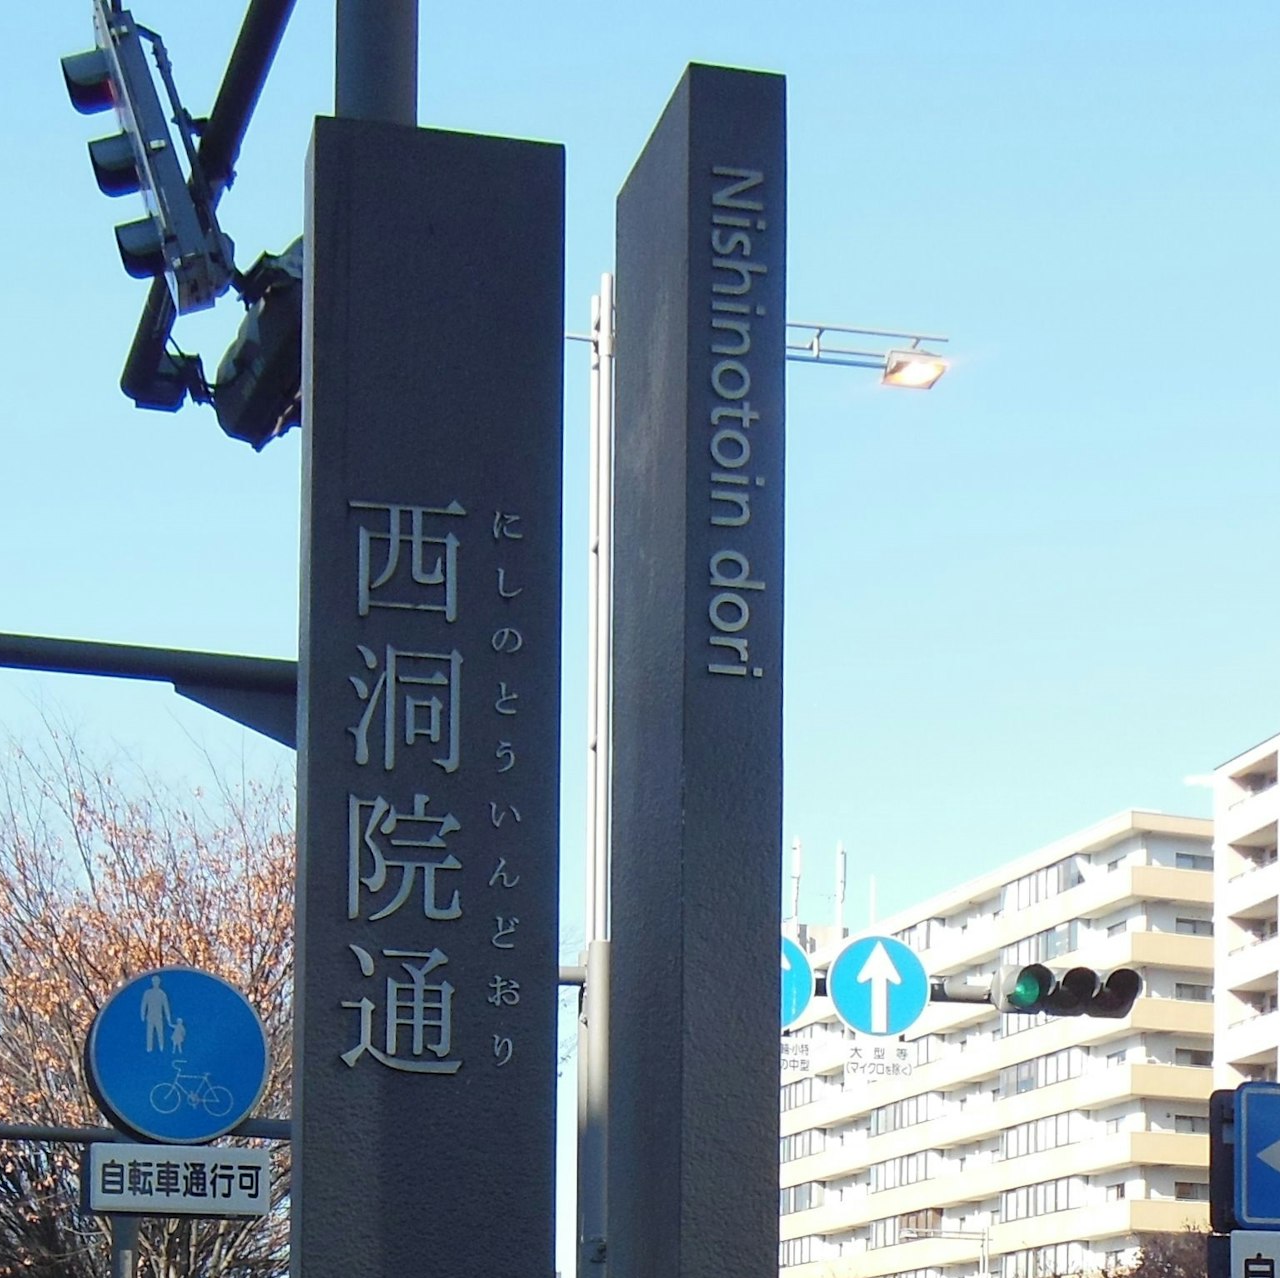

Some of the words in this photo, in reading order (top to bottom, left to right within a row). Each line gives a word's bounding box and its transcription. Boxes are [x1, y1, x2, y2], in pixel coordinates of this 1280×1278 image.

[709, 165, 768, 528] Nishinotoin
[339, 498, 468, 1076] 西洞院通
[487, 508, 524, 1068] にしのとういんどおり
[707, 548, 766, 679] dori
[100, 1159, 262, 1200] 自転車通行可
